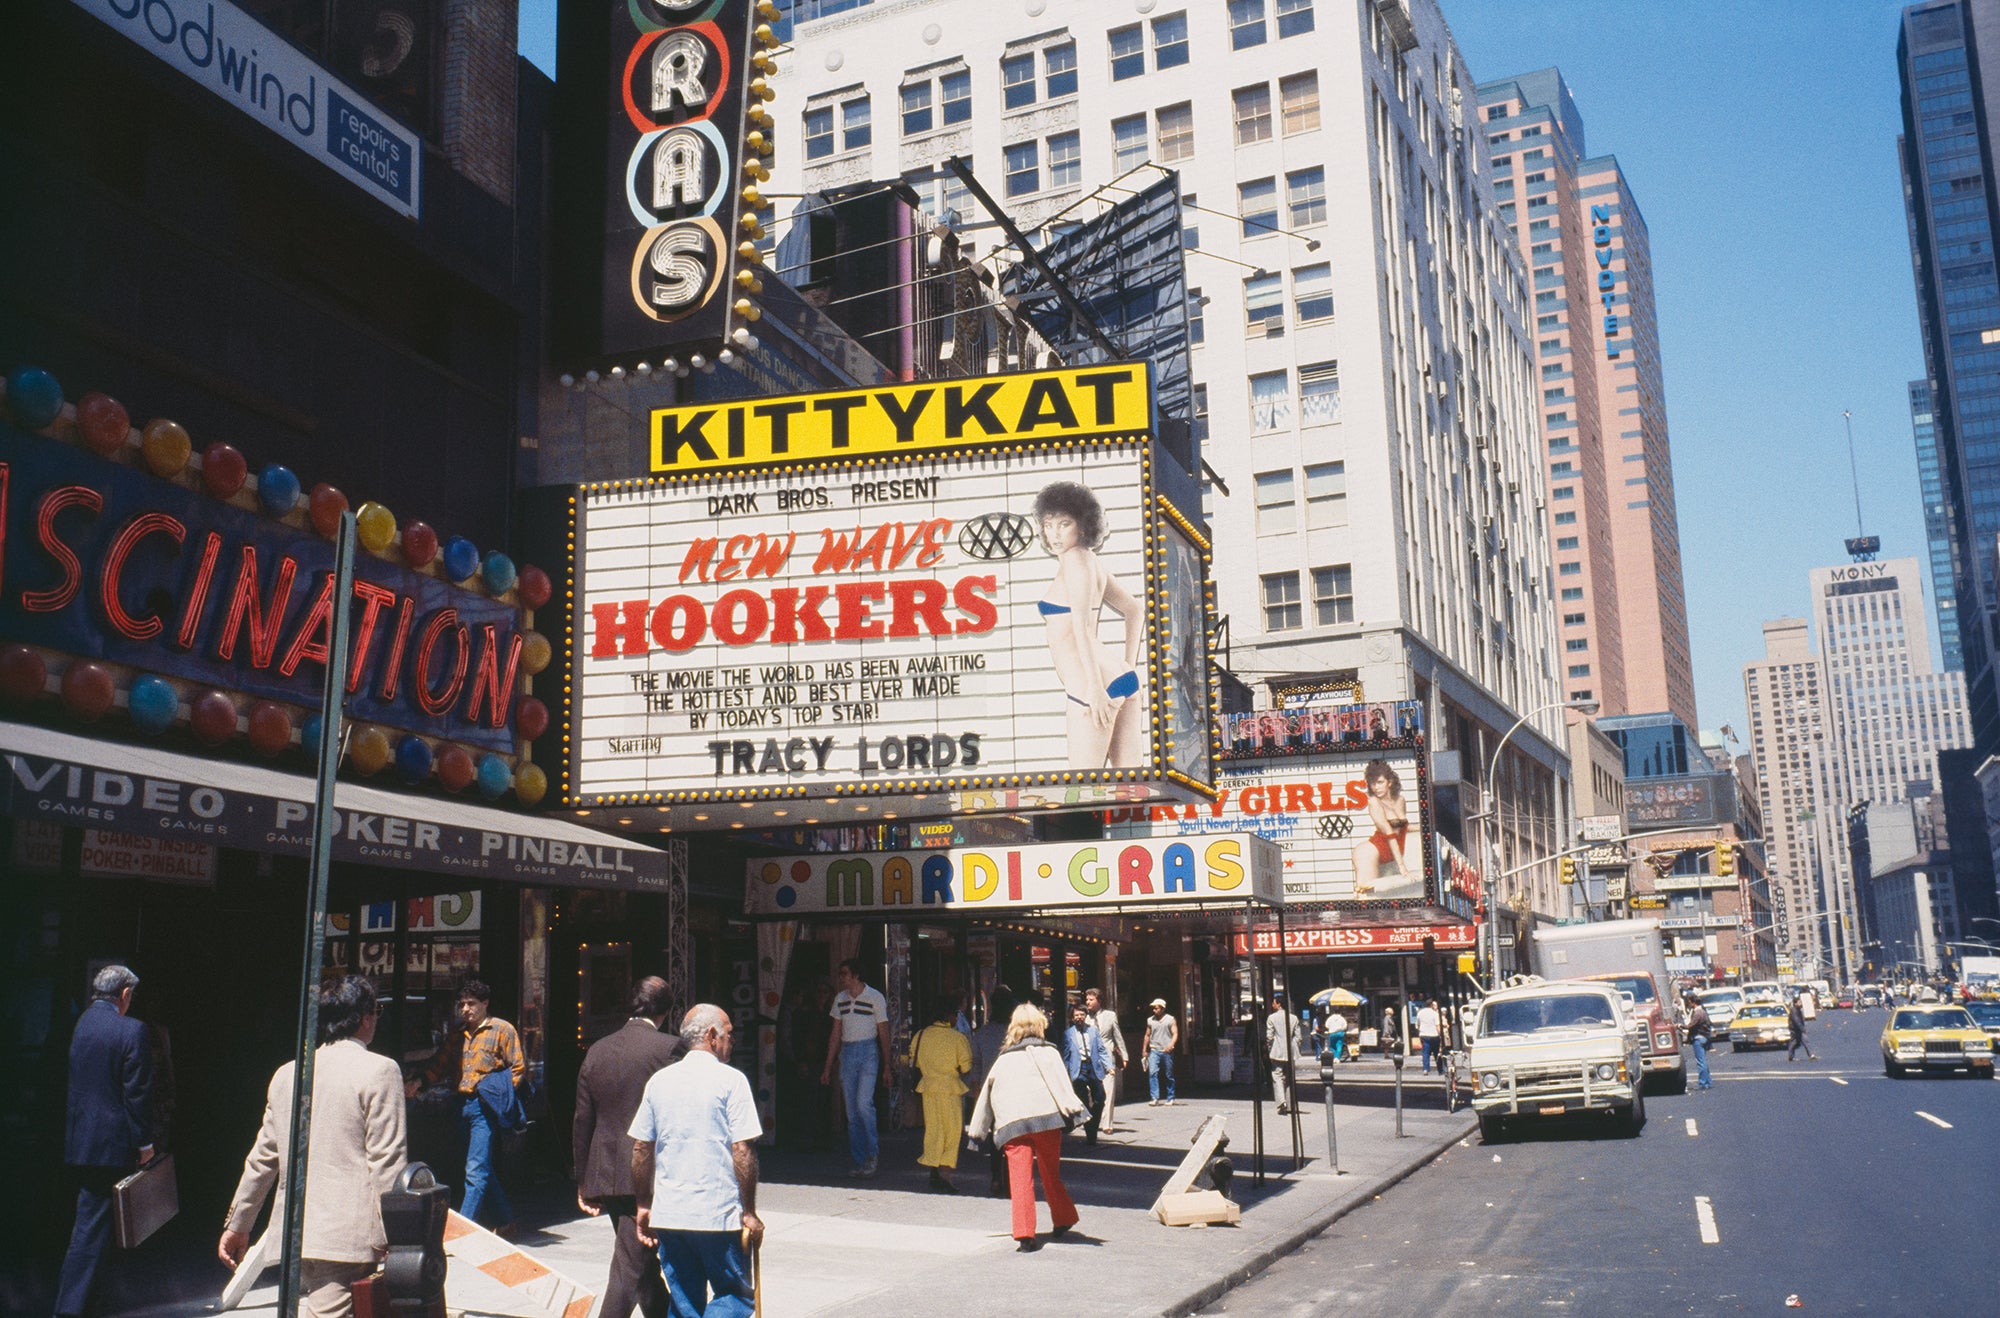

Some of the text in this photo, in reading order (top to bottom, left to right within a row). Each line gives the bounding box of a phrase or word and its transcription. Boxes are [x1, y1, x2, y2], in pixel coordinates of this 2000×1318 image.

[340, 107, 400, 162] repairs
[340, 135, 399, 188] rentals
[651, 0, 707, 307] RAS
[1590, 202, 1620, 361] NOVOTEL
[660, 369, 1134, 466] KITTYKAT
[707, 476, 942, 517] DARK BROS. PRESENT
[678, 517, 953, 583] NEW WAVE
[1830, 562, 1887, 582] MONY
[0, 462, 522, 729] SCINATION
[591, 574, 1000, 661] HOOKERS
[631, 653, 987, 692] THE MOVIE THE WORLD HAS BEEN AWAITING
[644, 675, 962, 713] THE HOTTEST AND BEST EVER MADE
[689, 702, 880, 729] BY TODAY'S TOP STAR!
[608, 735, 662, 755] Starring
[706, 731, 982, 776] TRACY LORDS
[1222, 777, 1263, 789] DERENZY'S
[1238, 778, 1369, 816] GIRLS
[11, 756, 225, 819] VIDEO
[481, 831, 635, 873] PINBALL
[38, 799, 116, 821] GAMES
[159, 817, 228, 835] GAMES
[919, 824, 954, 835] VIDEO
[1177, 818, 1203, 832] You'll
[1205, 817, 1234, 830] Never
[1236, 814, 1261, 829] Look
[1264, 816, 1276, 826] at
[1257, 826, 1294, 841] Again!
[1590, 830, 1620, 839] BAKING
[96, 829, 153, 850] GAMES
[158, 837, 209, 857] INSIDE
[266, 832, 314, 847] GAME
[925, 836, 951, 847] XXX
[82, 847, 133, 871] POKER
[140, 853, 207, 878] PINBALL
[359, 845, 413, 861] GAMES
[442, 855, 490, 869] GAMES
[514, 864, 557, 876] GAMES
[580, 870, 618, 883] GAMES
[826, 850, 1024, 907] MARDI
[1067, 839, 1245, 898] GRAS
[1660, 918, 1687, 927] AMERICAN
[1284, 929, 1374, 948] EXPRESS
[1390, 933, 1411, 943] FAST
